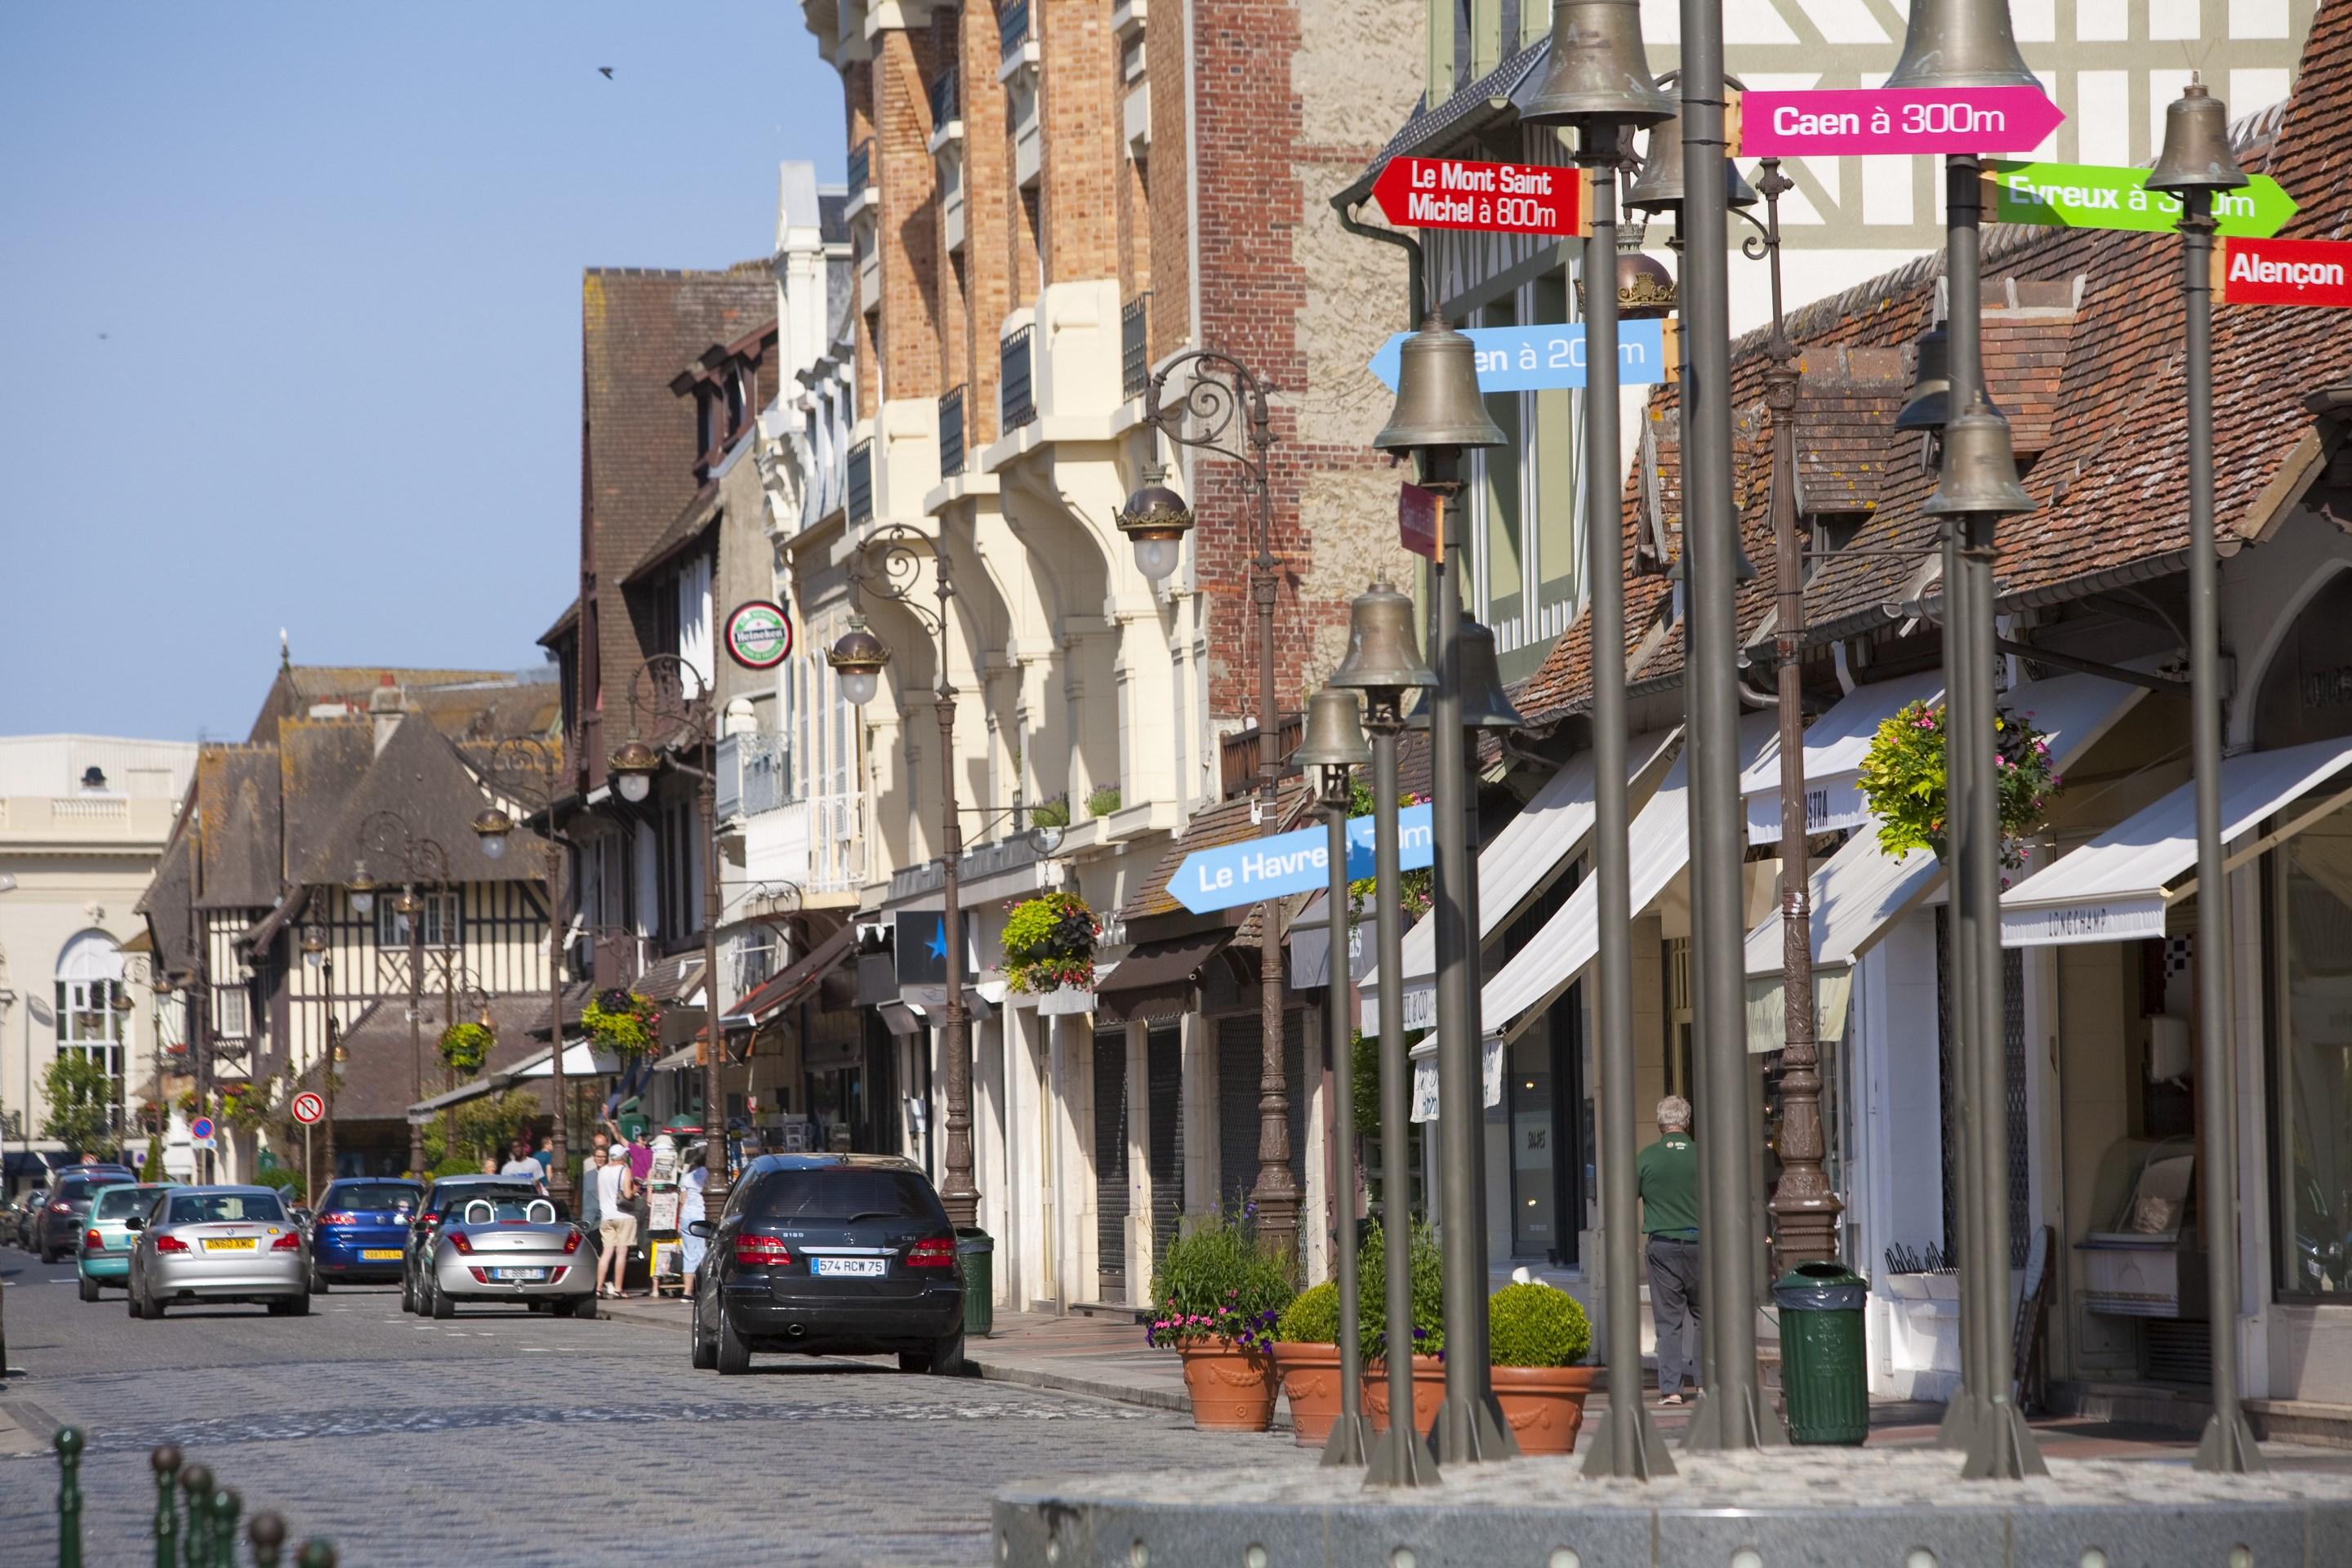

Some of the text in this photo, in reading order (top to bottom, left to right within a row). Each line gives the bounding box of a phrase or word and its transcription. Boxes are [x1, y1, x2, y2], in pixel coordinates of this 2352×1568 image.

[1773, 102, 2005, 136] Caen à 300m
[1411, 160, 1552, 195] Le Mont Saint
[2008, 176, 2119, 210] Evreux
[2128, 183, 2147, 212] à
[1408, 193, 1556, 227] Michel à 800m
[2229, 252, 2344, 291] Alençon
[1519, 342, 1537, 370] à
[1548, 337, 1646, 369] 20m
[1199, 865, 1233, 893] Le
[1241, 847, 1329, 884] Havre
[2049, 908, 2106, 937] LONGCHAMP
[820, 1260, 883, 1272] 574 RCW 75
